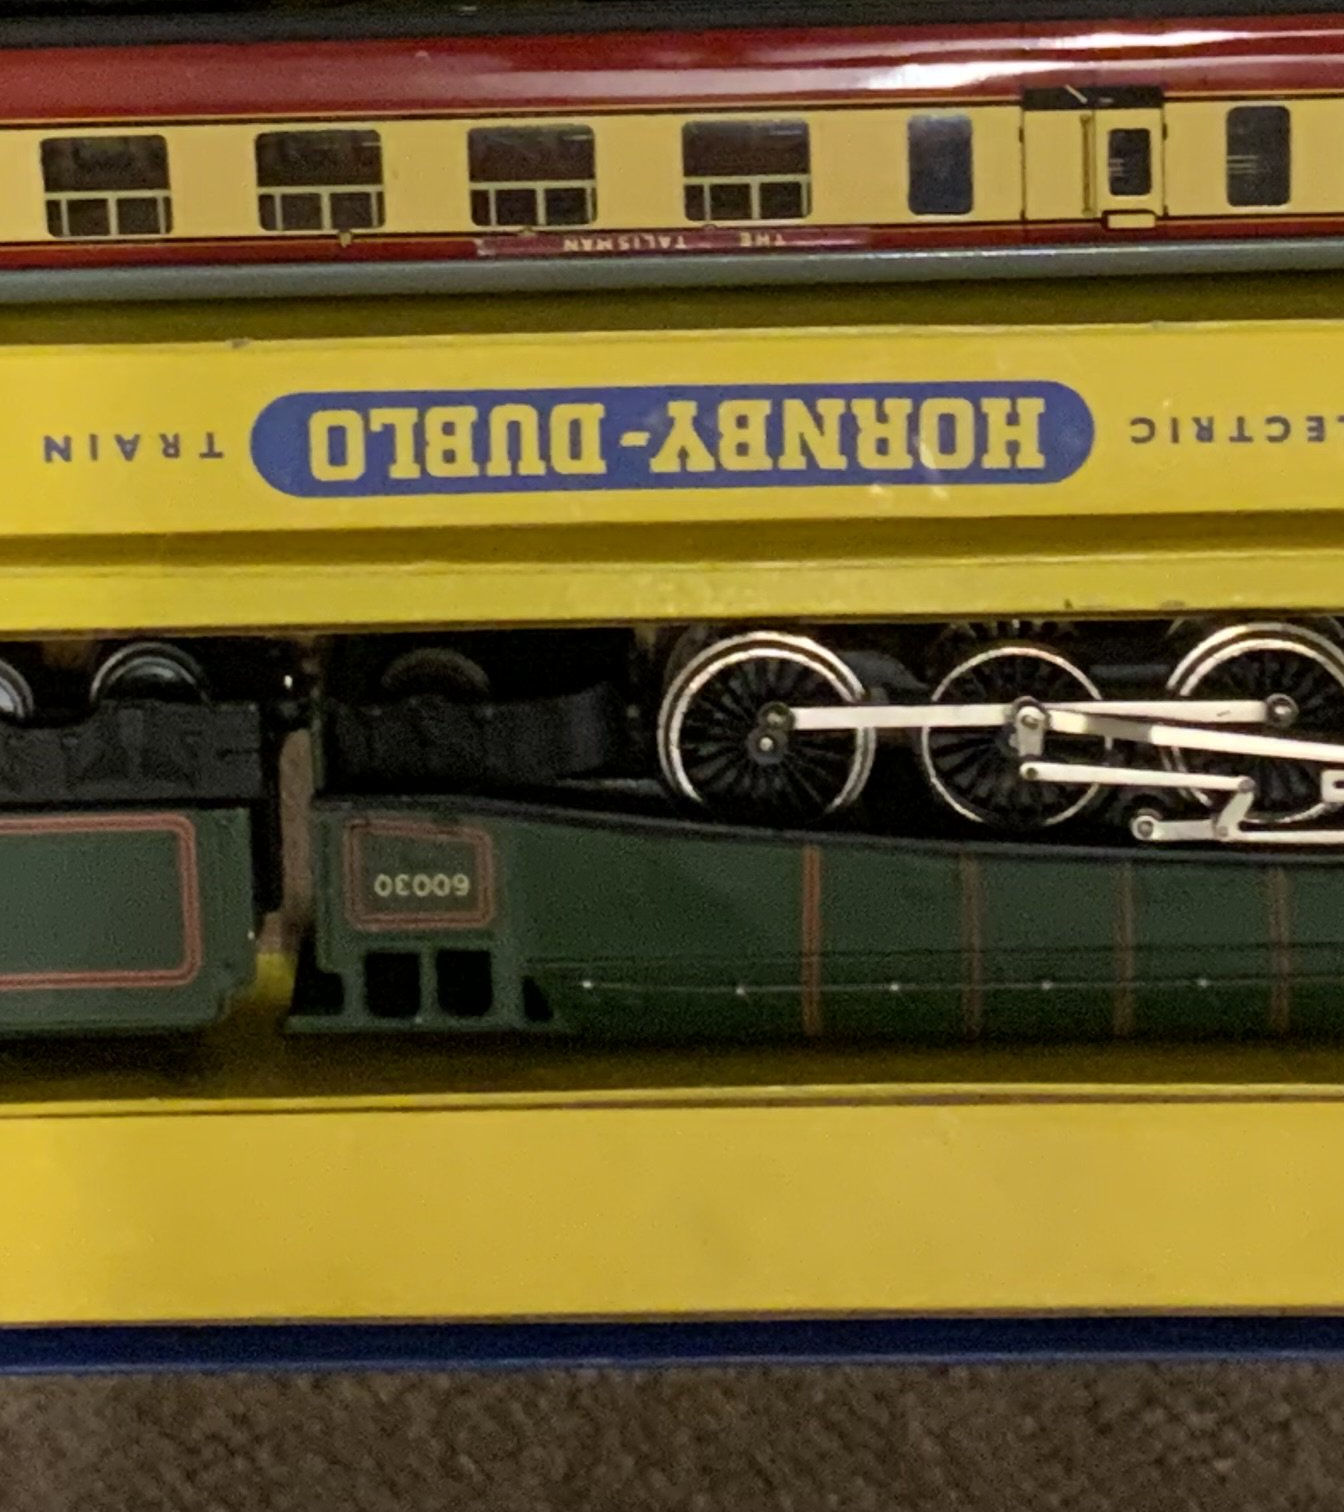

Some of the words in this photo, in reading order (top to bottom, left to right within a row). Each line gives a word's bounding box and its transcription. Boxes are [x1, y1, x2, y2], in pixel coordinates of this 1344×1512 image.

[563, 235, 687, 251] TALISMAN
[740, 232, 785, 247] THE
[43, 434, 223, 461] TRAIN
[310, 398, 1044, 480] HORNBY-DUBLO
[374, 874, 470, 897] 60030
